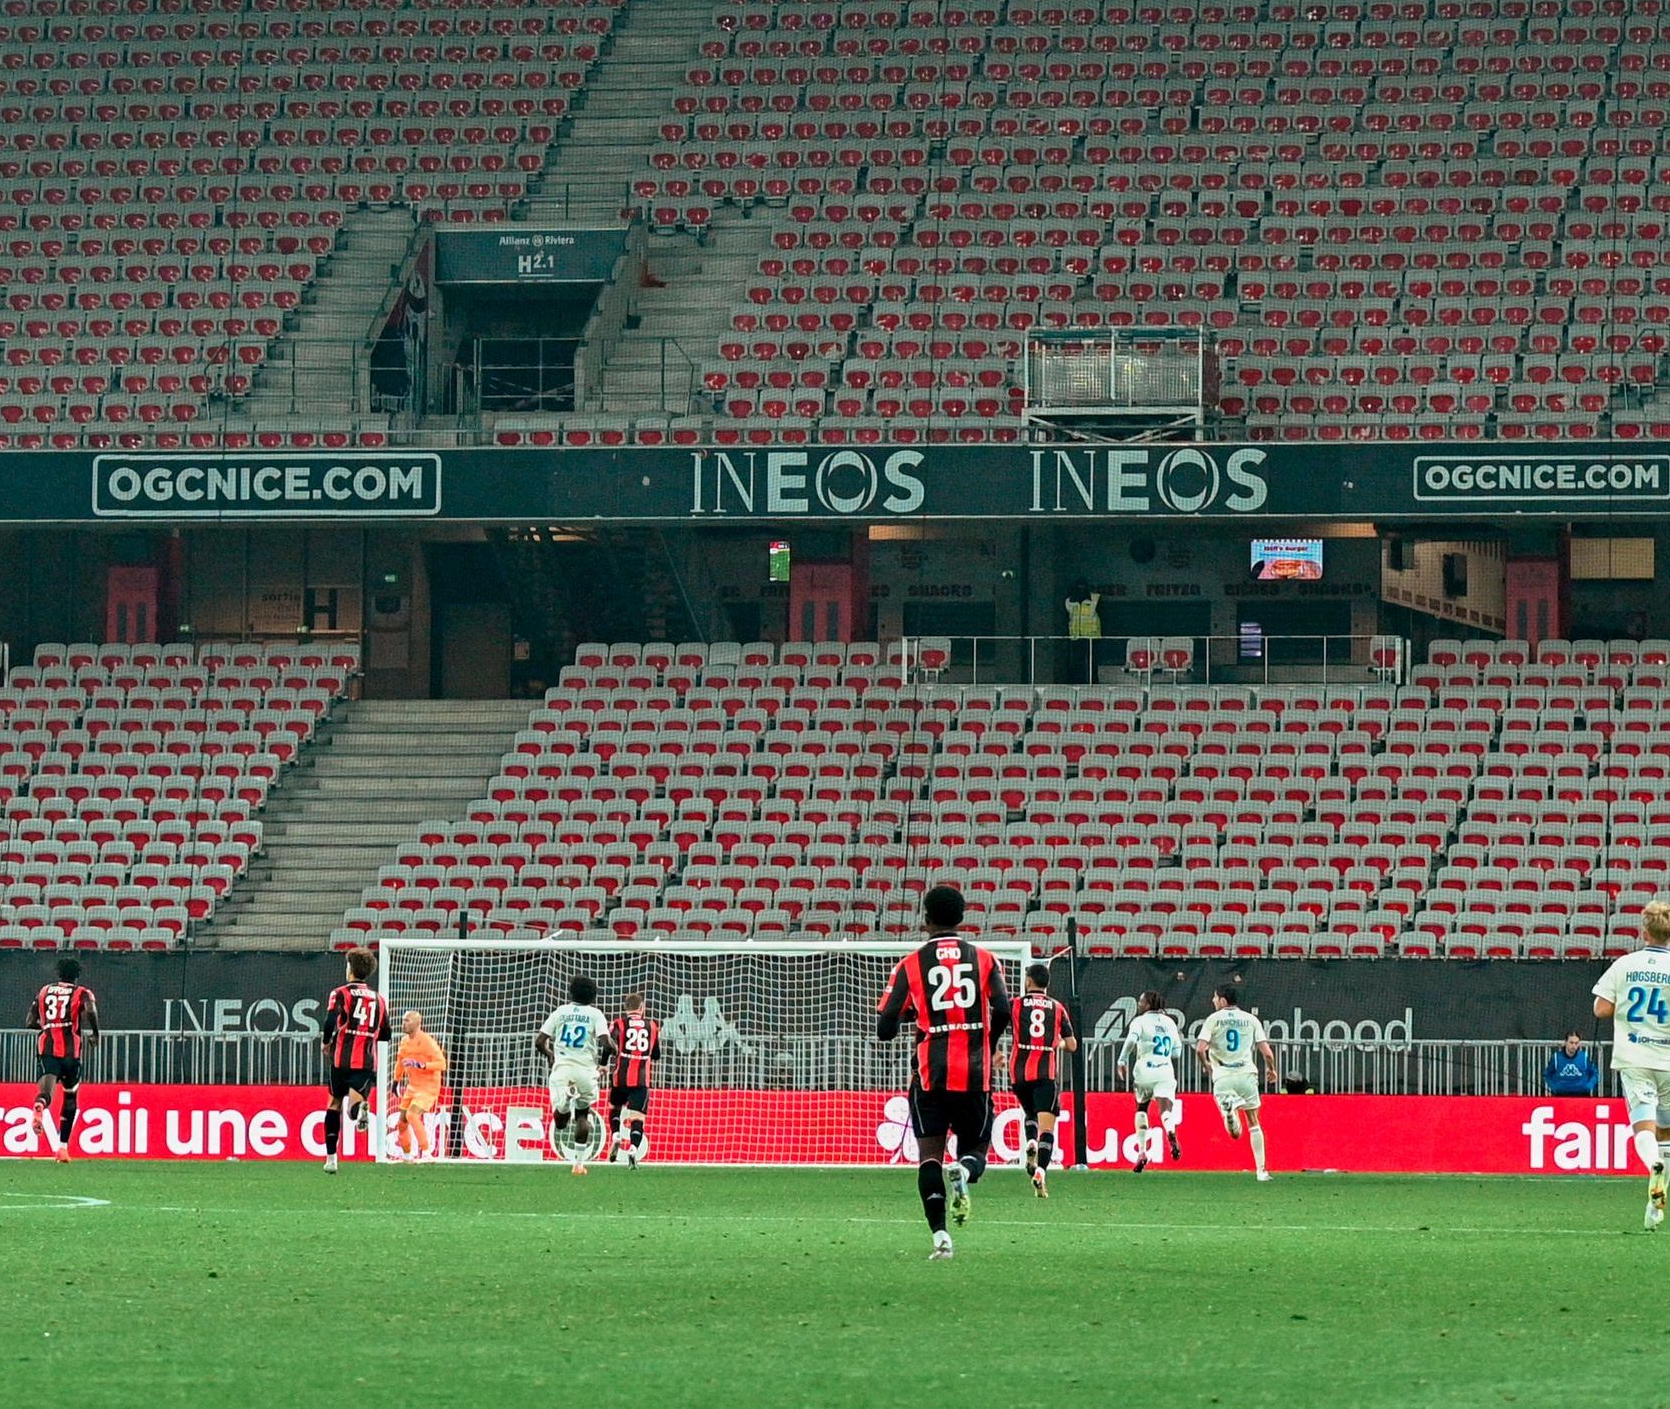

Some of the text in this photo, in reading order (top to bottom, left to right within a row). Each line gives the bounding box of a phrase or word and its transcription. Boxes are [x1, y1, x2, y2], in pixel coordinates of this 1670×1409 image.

[108, 466, 423, 501] OGCNICE.COM
[690, 451, 925, 513] INEOS
[1029, 449, 1268, 513] INEOS
[1425, 464, 1660, 491] OGCNICE.COM
[927, 963, 977, 1012] 25
[45, 994, 70, 1020] 37
[163, 997, 321, 1043] INEOS
[353, 997, 376, 1028] 41
[1626, 986, 1669, 1024] 24
[560, 1023, 587, 1049] 42
[625, 1028, 650, 1052] 26
[1029, 1009, 1046, 1038] 8
[1226, 1029, 1240, 1052] 9
[166, 1109, 288, 1158] une
